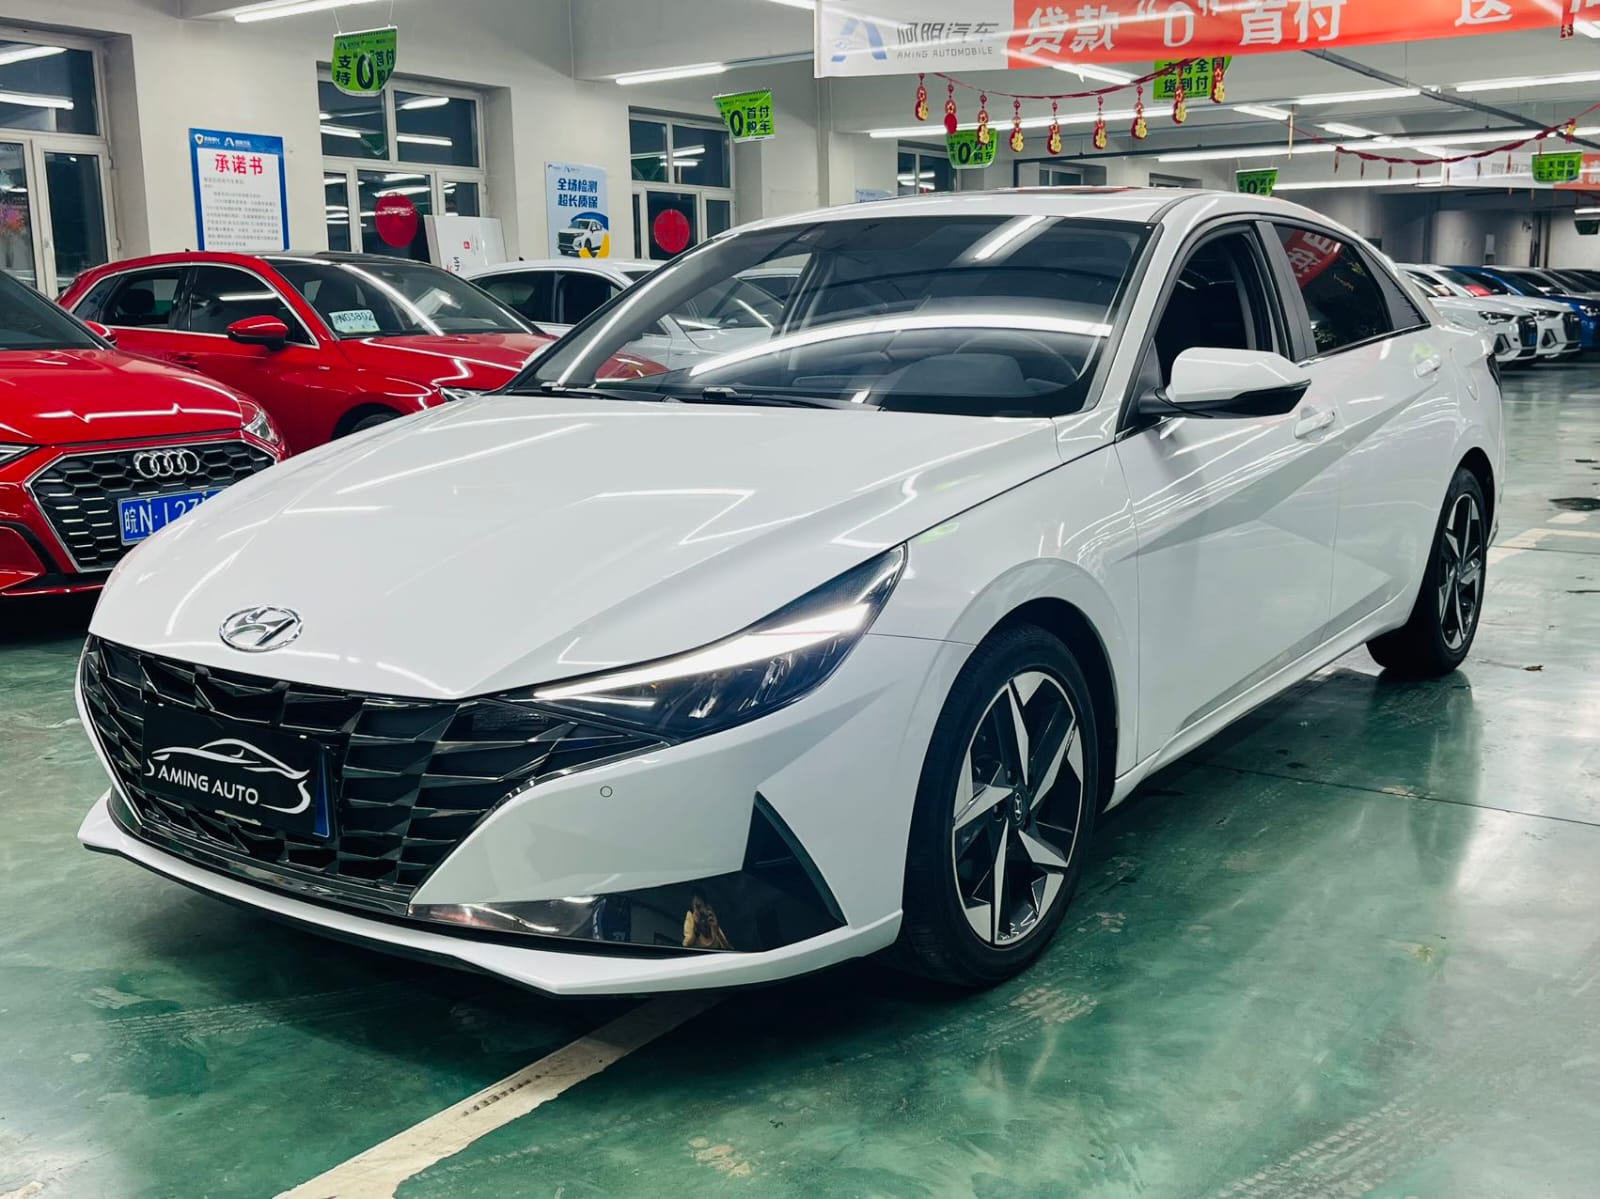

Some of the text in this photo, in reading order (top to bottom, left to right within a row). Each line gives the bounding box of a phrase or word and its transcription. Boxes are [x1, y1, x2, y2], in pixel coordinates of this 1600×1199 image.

[897, 46, 993, 59] AMING AUTOMOBILE
[215, 154, 263, 175] 承诺书
[557, 178, 598, 193] 全场检测
[558, 194, 598, 208] 超长质保
[158, 765, 259, 805] AMING AUTO
